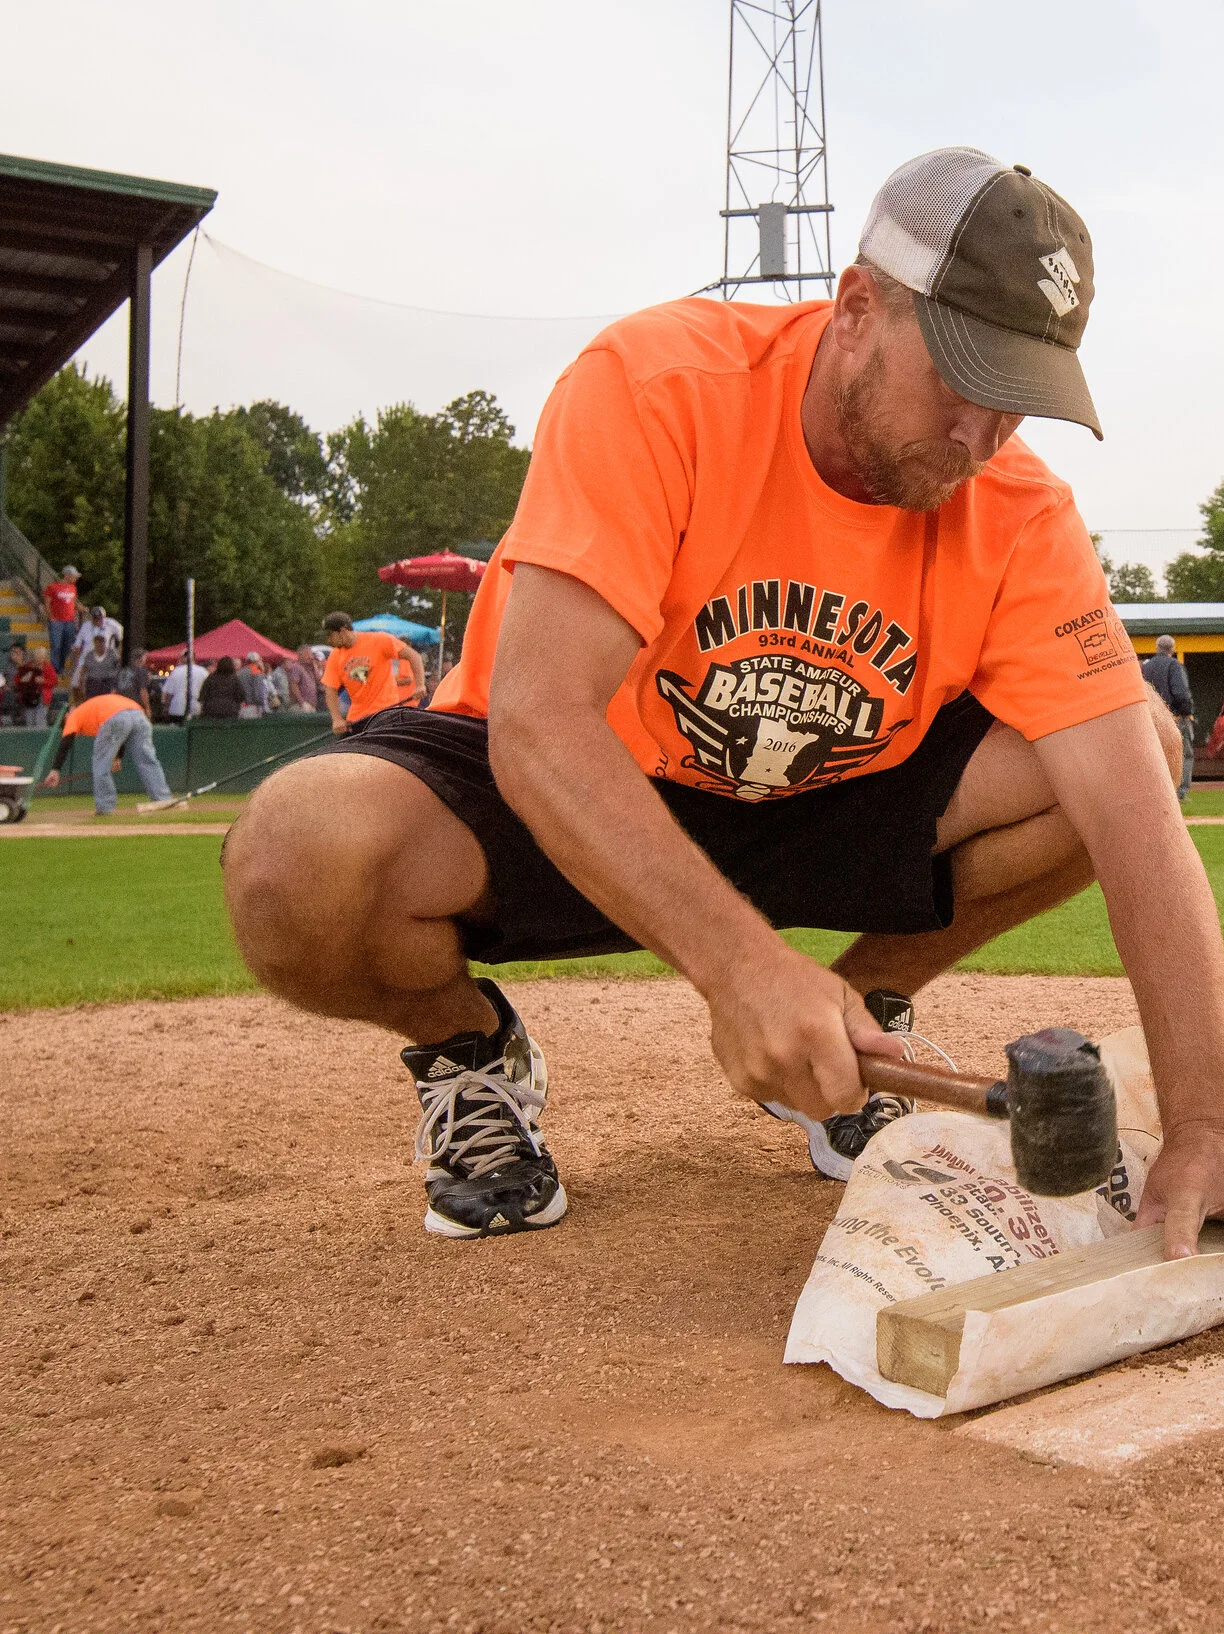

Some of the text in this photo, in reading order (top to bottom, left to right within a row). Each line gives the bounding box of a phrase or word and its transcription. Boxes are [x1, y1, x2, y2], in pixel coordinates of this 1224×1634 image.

[1048, 257, 1075, 306] SAINTS
[694, 578, 918, 697] MINNESOTA
[1054, 609, 1104, 638] COKATO
[758, 632, 855, 668] 93rd ANNAL
[739, 656, 861, 697] STATE AMATEUR
[703, 669, 874, 738] BASEBALL
[728, 704, 847, 735] CHAMPIONSHIPS
[762, 738, 797, 753] 2016
[888, 1019, 911, 1032] adidas
[427, 1064, 467, 1078] adidas
[940, 1187, 969, 1206] 33
[489, 1219, 510, 1229] adidas
[833, 1217, 869, 1235] ing
[863, 1222, 900, 1246] the
[919, 1192, 982, 1252] Phoenix,
[849, 1264, 876, 1285] Rights
